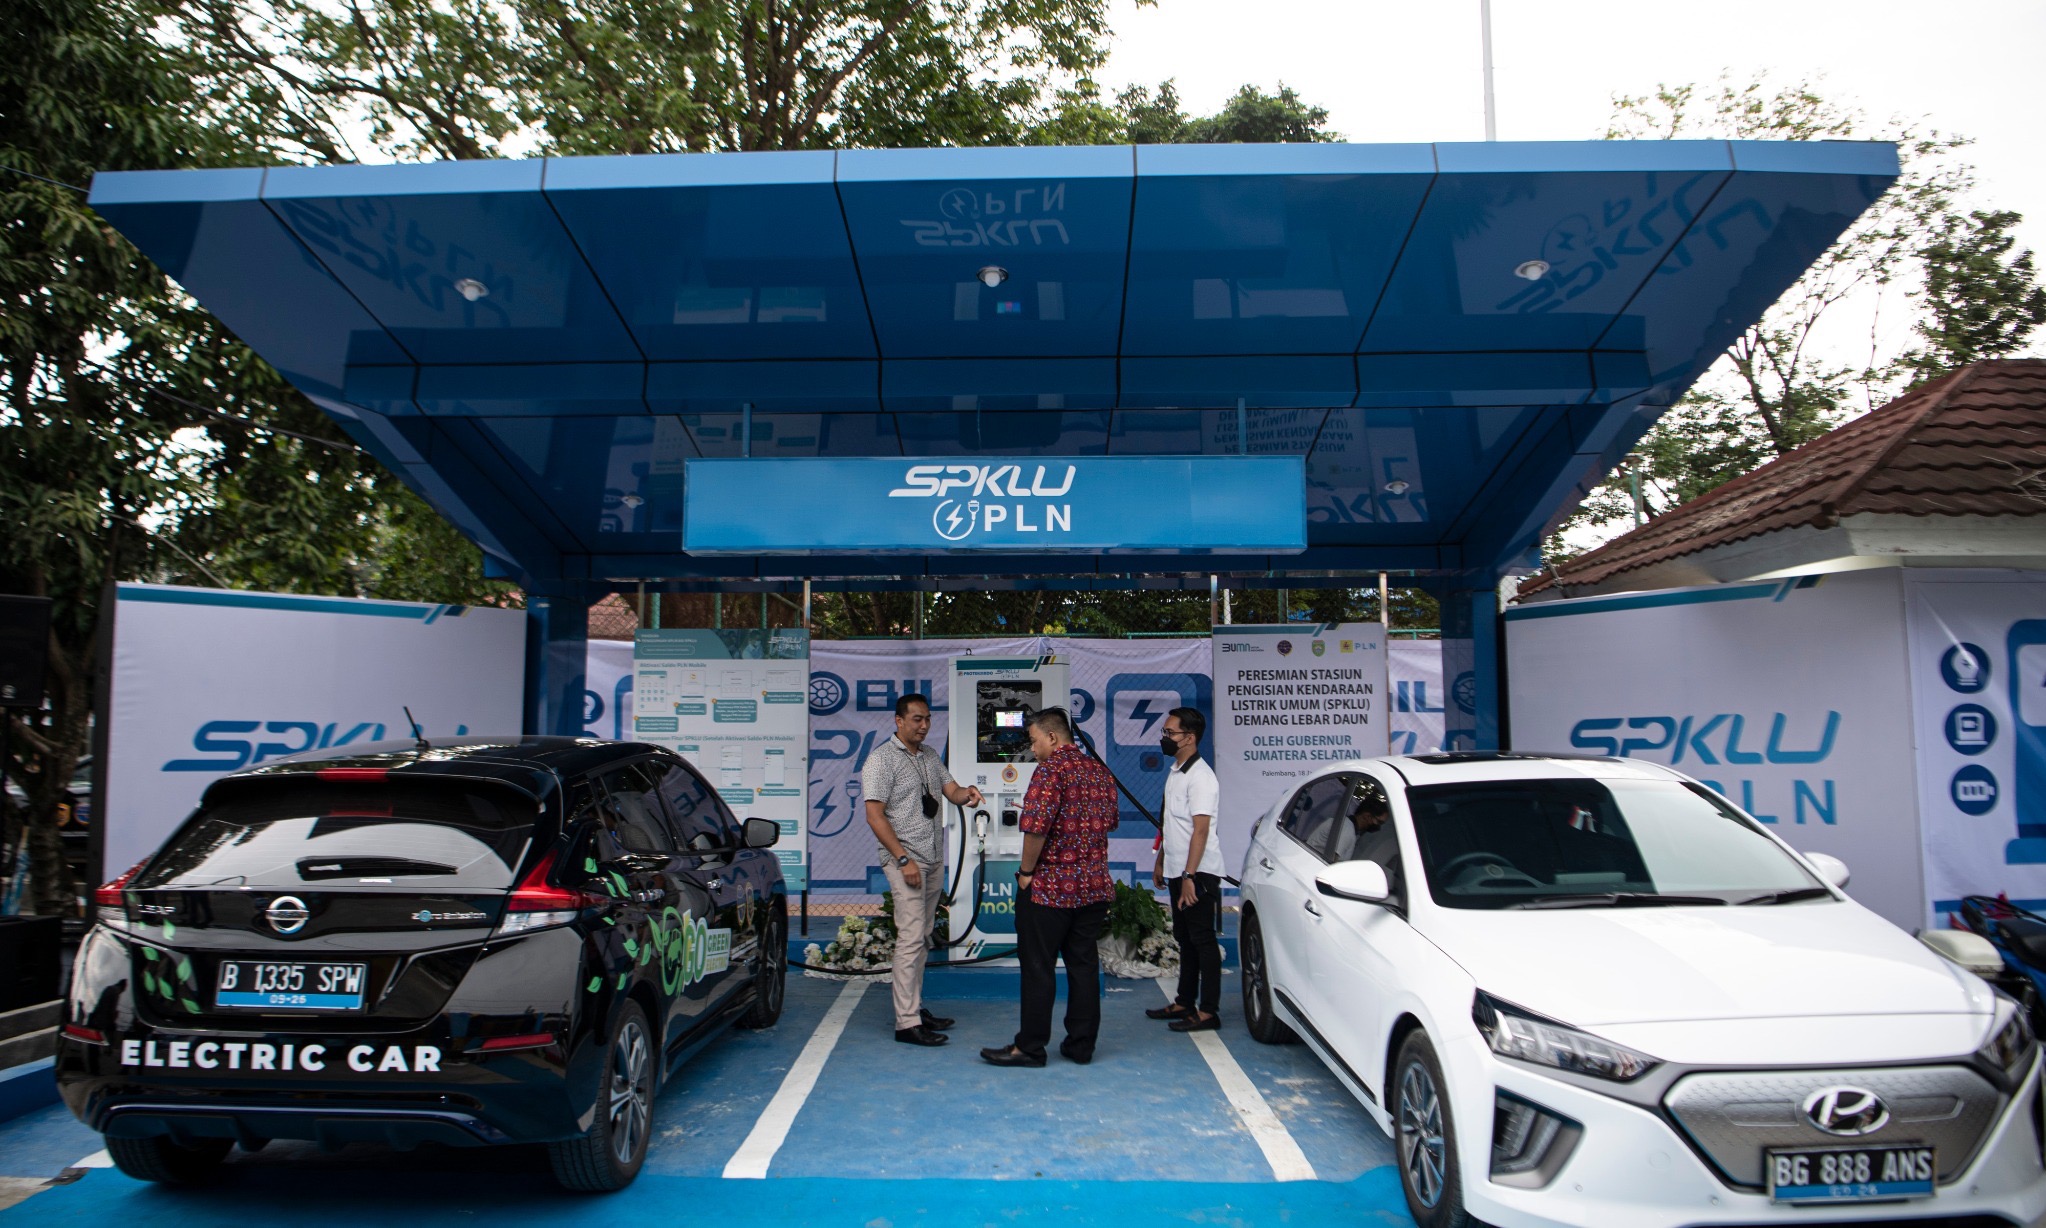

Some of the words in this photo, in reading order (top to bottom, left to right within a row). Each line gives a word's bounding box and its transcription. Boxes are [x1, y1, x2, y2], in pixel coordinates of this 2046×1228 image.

[888, 465, 1077, 497] SPKLU
[984, 505, 1071, 532] PLN
[1222, 643, 1250, 652] BUMN
[1355, 642, 1376, 650] PLN
[1238, 670, 1307, 681] PERESMIAN
[1311, 669, 1362, 680] STASIUN
[1228, 685, 1293, 696] PENGISIAN
[1297, 684, 1373, 695] KENDARAAN
[1231, 700, 1277, 711] LISTRIK
[1280, 699, 1320, 710] UMUM
[1323, 699, 1370, 711] (SPKLU)
[1234, 714, 1288, 726] DEMANG
[1291, 714, 1330, 725] LEBAR
[1333, 713, 1368, 725] DAUN
[1252, 736, 1284, 746] OLEH
[1287, 735, 1352, 746] GUBERNUR
[1570, 710, 1842, 766] SPKLU
[1243, 750, 1307, 761] SUMATERA
[1310, 749, 1361, 760] SELATAN
[708, 933, 730, 952] GREEN
[220, 964, 238, 990] B
[317, 966, 363, 993] SPW
[121, 1039, 327, 1071] ELECTRIC
[347, 1044, 442, 1072] CAR
[1775, 1155, 1810, 1187] BG
[1820, 1152, 1871, 1185] 888
[1881, 1150, 1933, 1182] ANS
